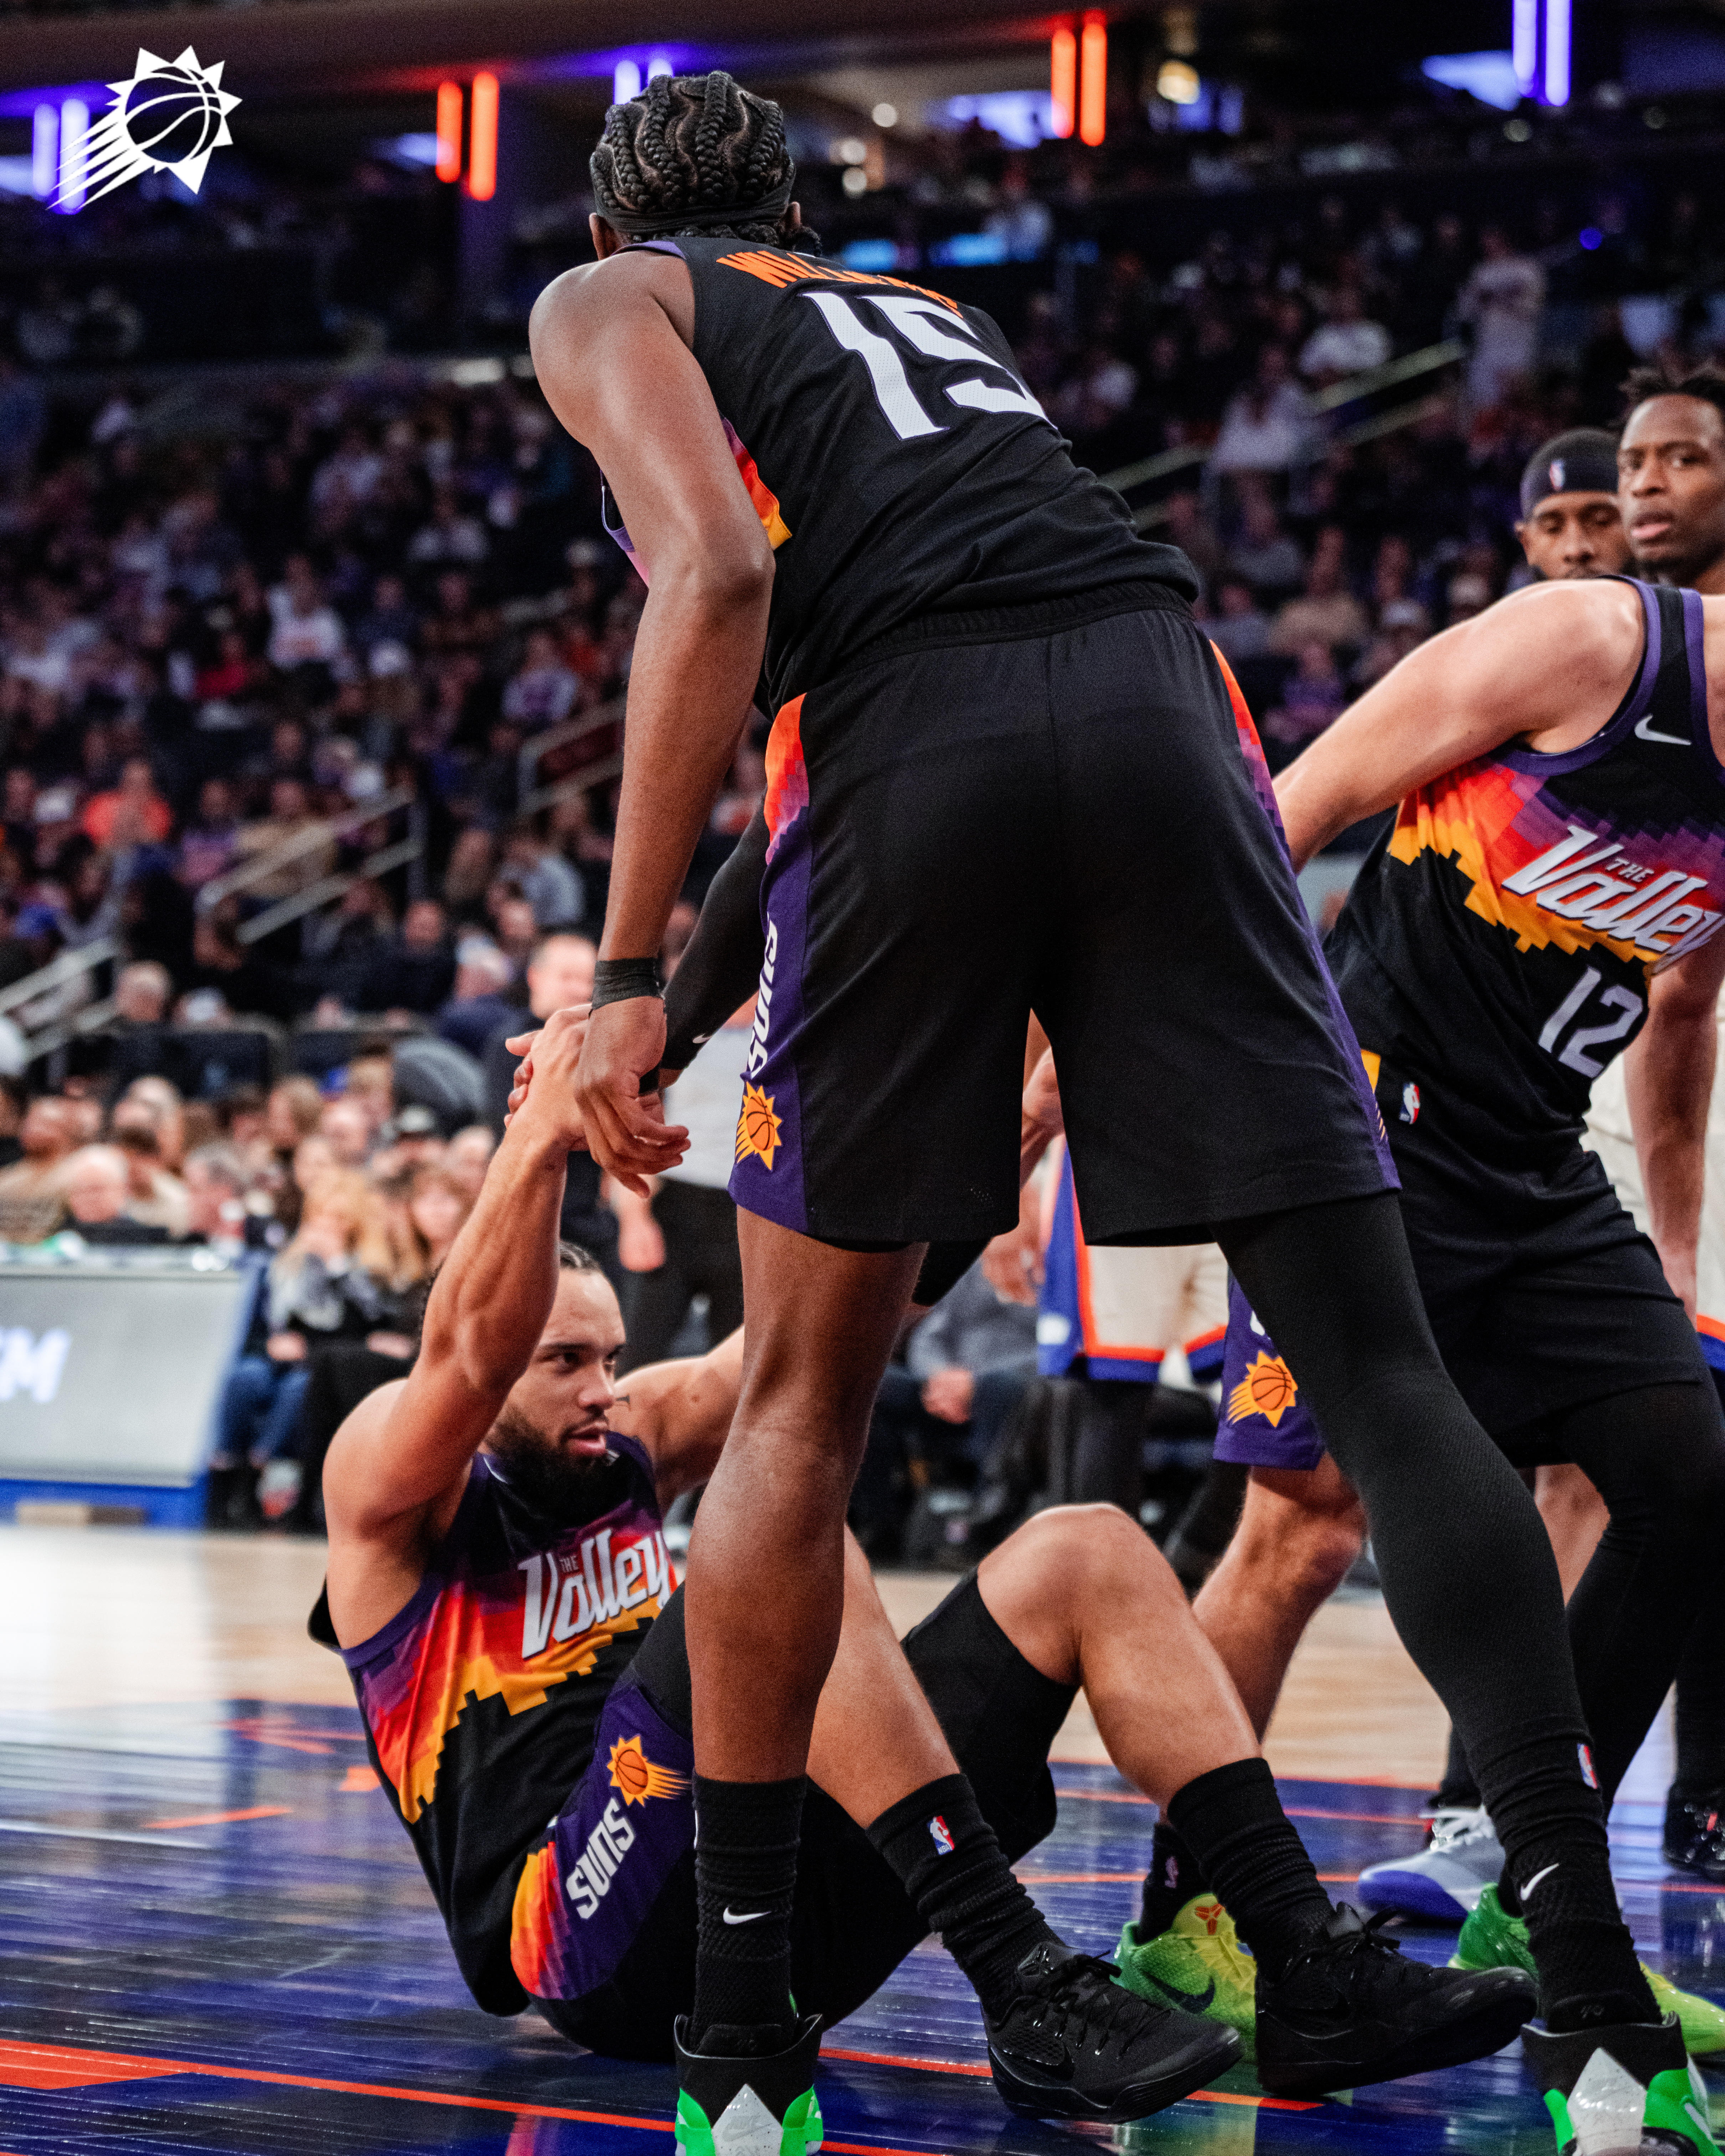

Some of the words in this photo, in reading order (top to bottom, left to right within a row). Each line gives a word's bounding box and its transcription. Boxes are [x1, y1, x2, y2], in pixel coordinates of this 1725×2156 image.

[801, 292, 1058, 441] 15
[1502, 825, 1725, 974] Valley
[1605, 857, 1654, 882] THE
[1538, 966, 1643, 1079] 12
[517, 1527, 671, 1660] Valley
[559, 1556, 579, 1573] THE
[565, 1797, 635, 1920] SUNS
[938, 1844, 951, 1854] NBA
